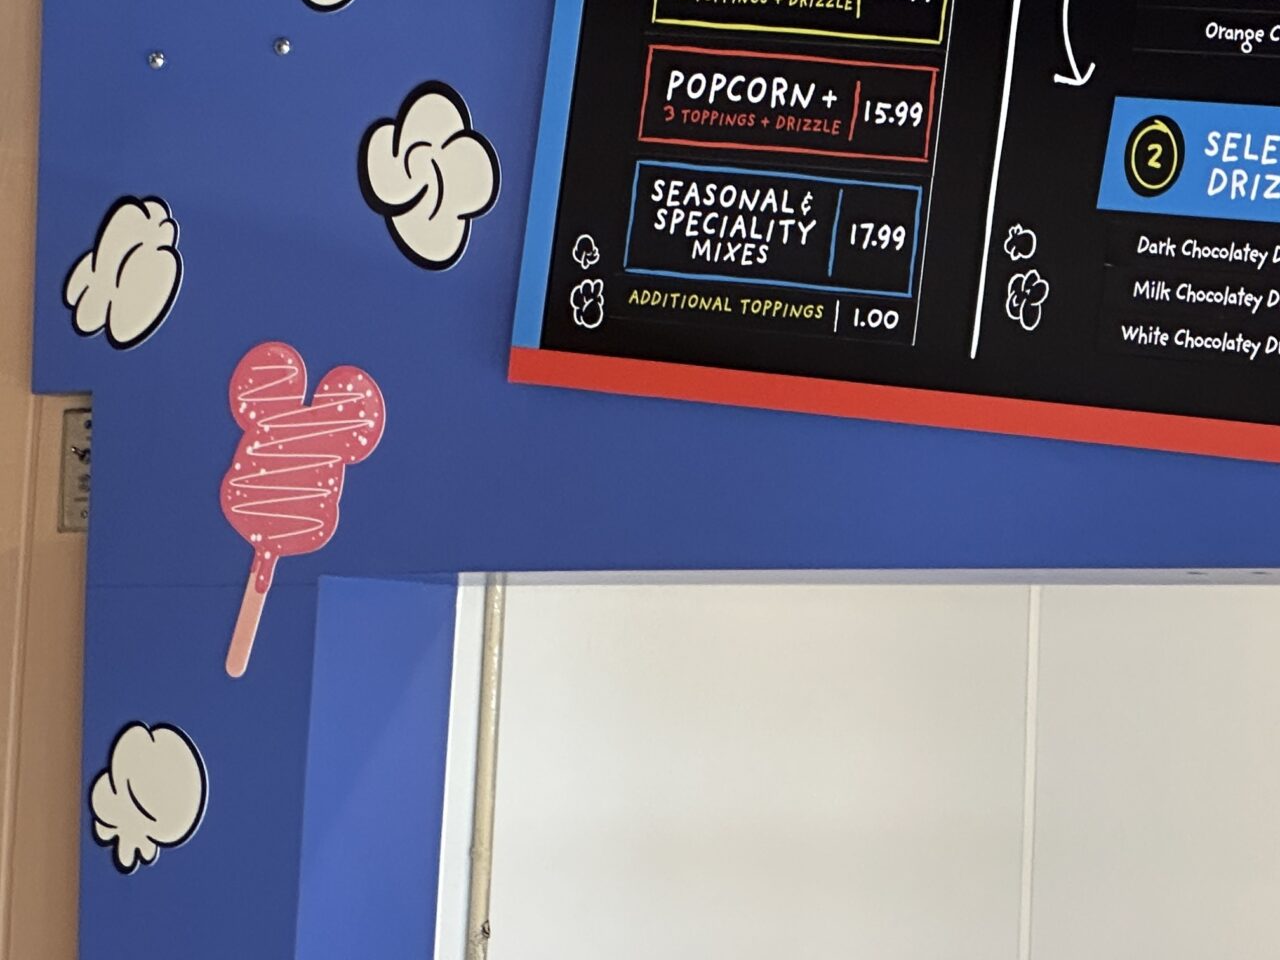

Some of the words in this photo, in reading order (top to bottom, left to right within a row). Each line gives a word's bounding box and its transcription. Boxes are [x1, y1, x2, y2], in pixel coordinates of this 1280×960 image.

[1205, 21, 1265, 54] Orange
[666, 70, 816, 108] POPCORN
[664, 105, 674, 121] 3
[681, 108, 755, 127] TOPPINGS
[776, 115, 841, 135] DRIZZLE
[864, 100, 923, 127] 15.99
[1147, 144, 1162, 168] 2
[651, 179, 792, 214] SEASONAL
[801, 191, 813, 215] &
[654, 209, 817, 246] SPECIALITY
[850, 223, 906, 250] 17.99
[692, 239, 769, 266] MIXES
[1137, 236, 1176, 256] Dark
[1181, 239, 1269, 270] Chocolatey
[629, 289, 732, 312] ADDITIONAL
[740, 299, 825, 319] TOPPINGS
[1133, 281, 1171, 301] Milk
[1176, 283, 1263, 314] Chocolatey
[853, 308, 899, 329] 1.00
[1121, 325, 1169, 346] White
[1174, 329, 1262, 360] Chocolatey
